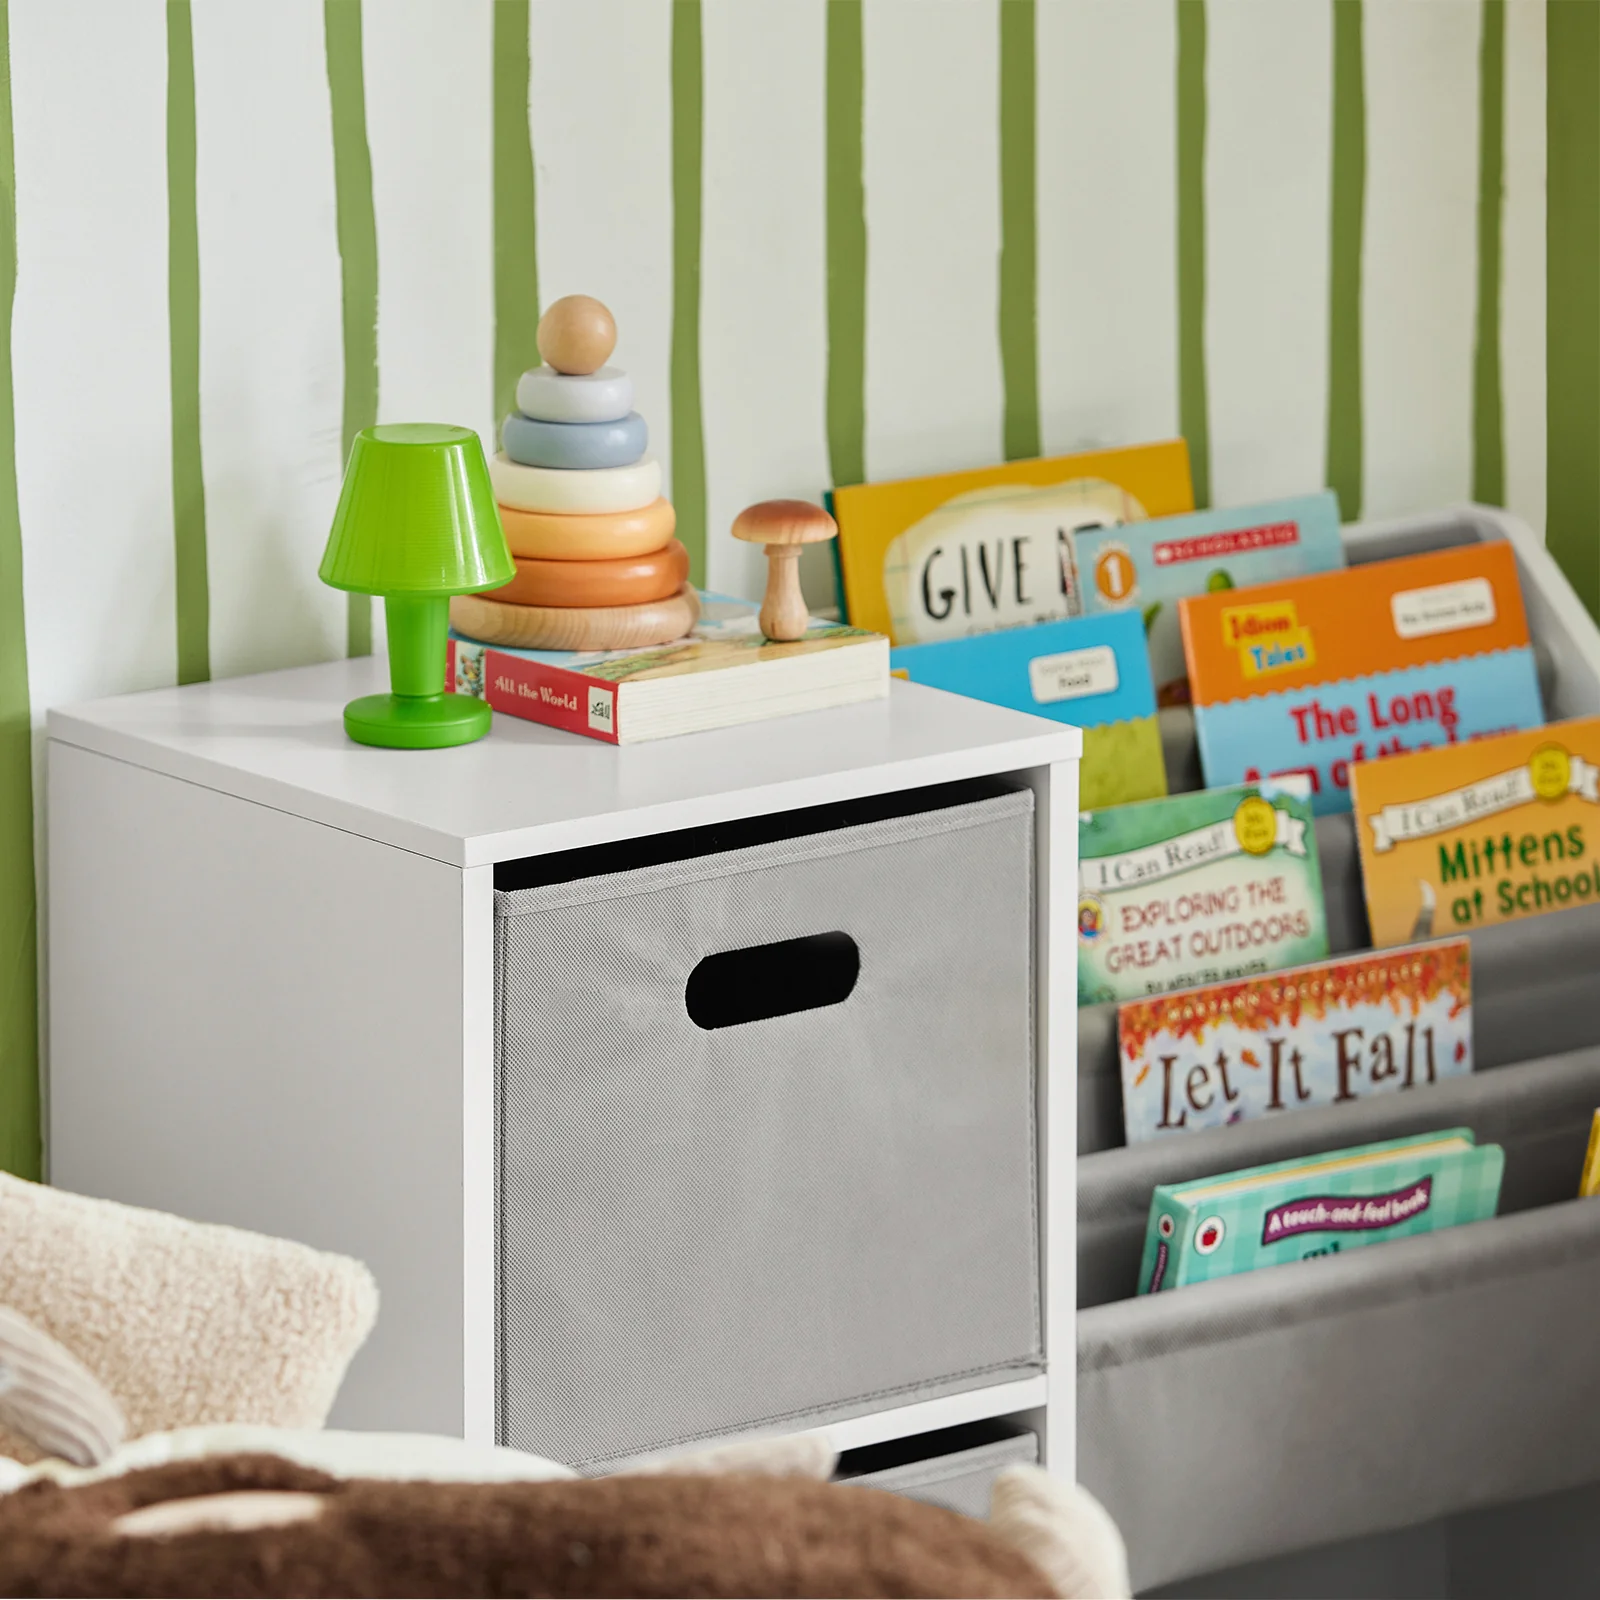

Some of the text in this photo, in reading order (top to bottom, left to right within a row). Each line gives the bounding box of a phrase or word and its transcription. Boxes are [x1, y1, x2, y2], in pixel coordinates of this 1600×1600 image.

[921, 537, 1034, 621] GIVE
[1104, 556, 1124, 597] 1
[1230, 613, 1290, 640] Idiom
[1249, 643, 1305, 671] Tales
[494, 675, 578, 711] All the World
[1288, 686, 1459, 744] The Long
[1402, 813, 1411, 835] I
[1415, 803, 1458, 829] Can
[1099, 829, 1227, 885] I Can Read!
[1438, 824, 1586, 884] Mittens
[1121, 876, 1286, 933] EXPLORING THE
[1452, 860, 1600, 924] at School
[1105, 910, 1311, 975] GREAT OUTDOORS
[1156, 1022, 1436, 1129] Let It Fall
[1269, 1187, 1428, 1233] A touch-and-feel book
